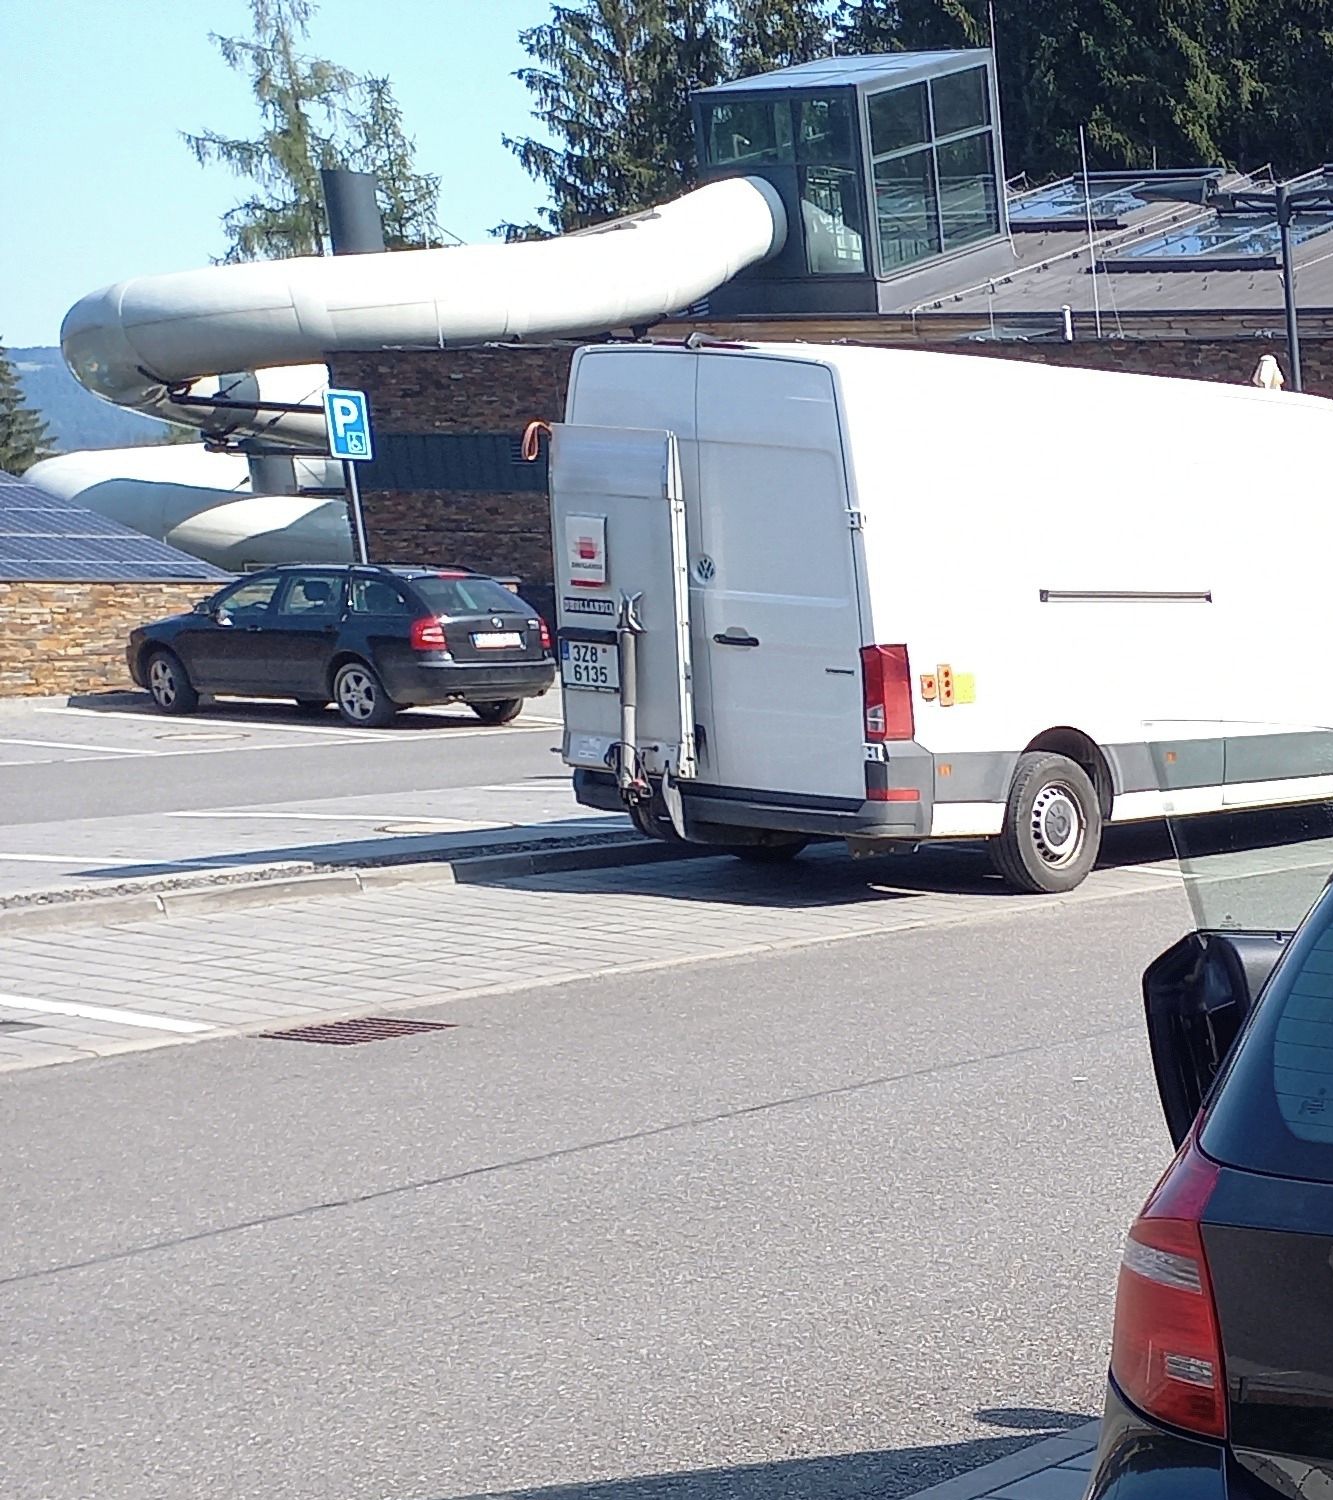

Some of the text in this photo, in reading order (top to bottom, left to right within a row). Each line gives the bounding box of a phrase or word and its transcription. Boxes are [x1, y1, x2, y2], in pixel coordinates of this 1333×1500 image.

[332, 398, 359, 438] P
[573, 645, 599, 663] 3Z8
[574, 664, 608, 684] 6135
